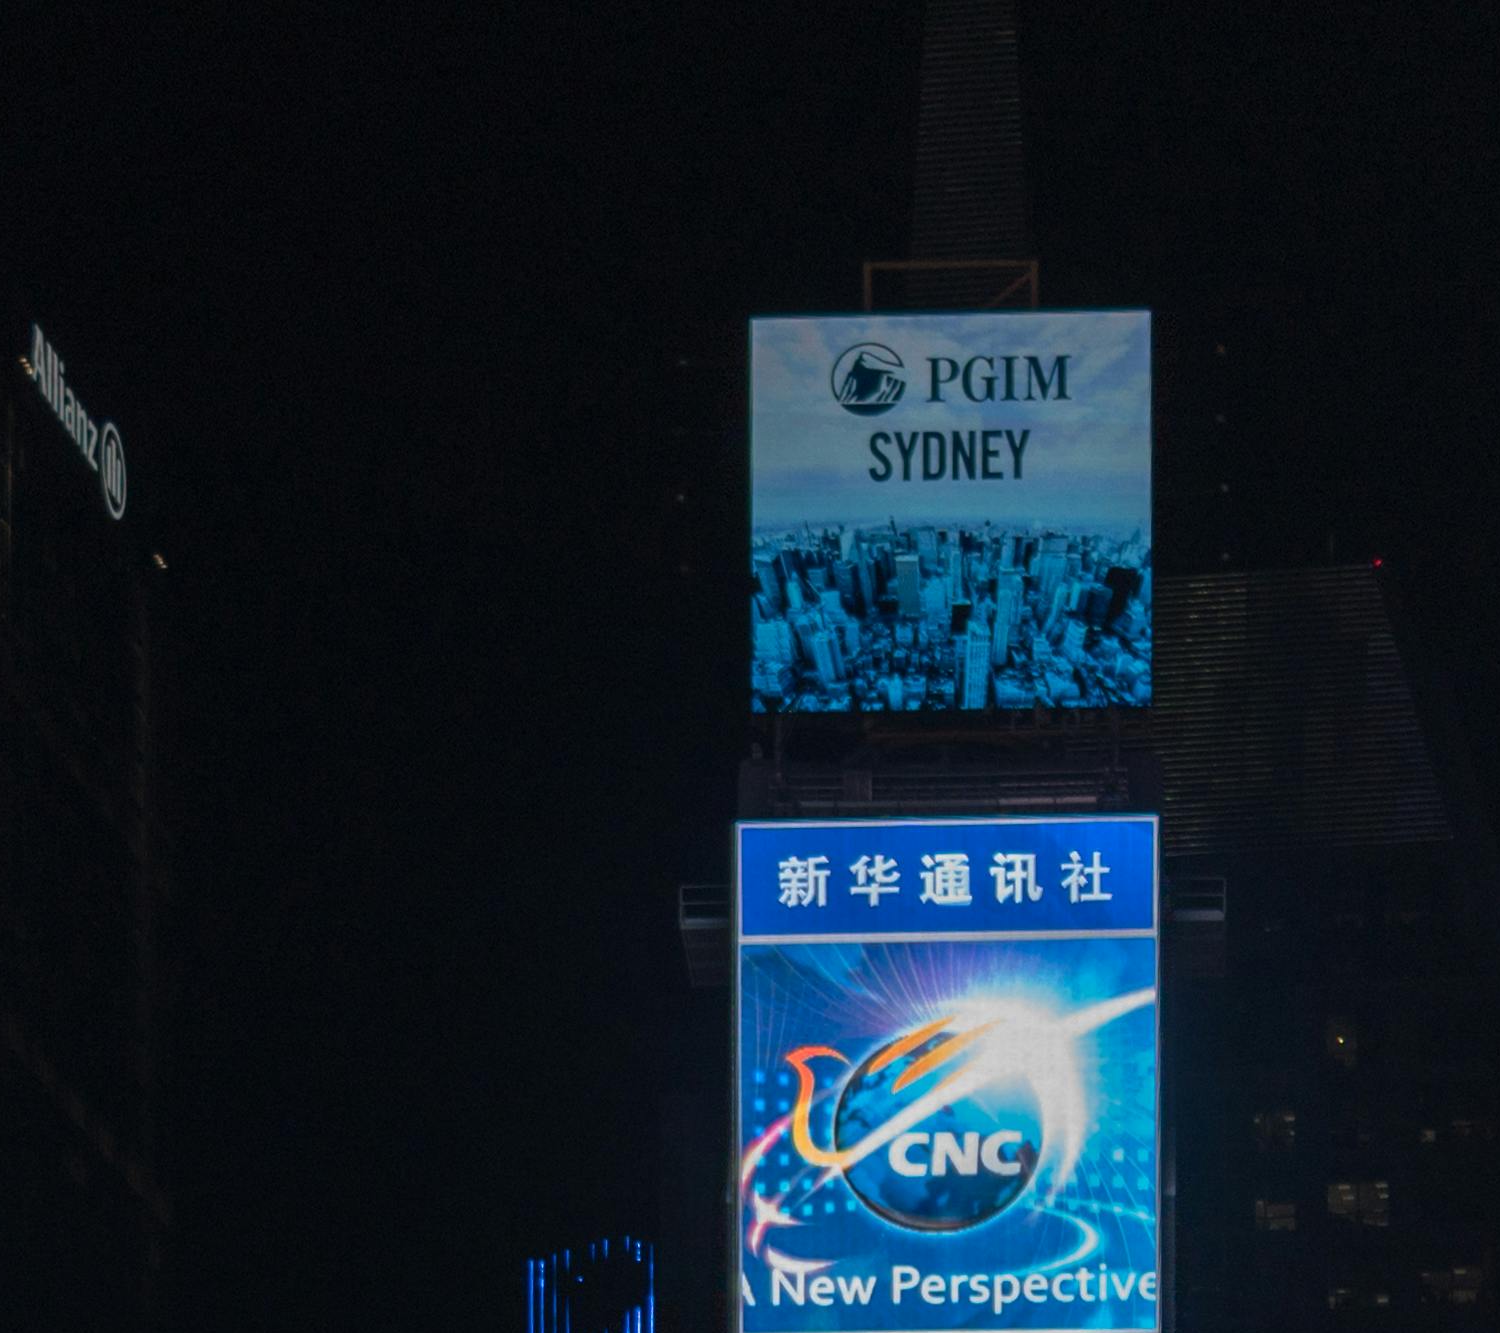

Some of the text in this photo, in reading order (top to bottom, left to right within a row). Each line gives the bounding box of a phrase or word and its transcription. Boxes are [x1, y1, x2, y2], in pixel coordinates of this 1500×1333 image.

[31, 324, 99, 471] Allianz
[927, 354, 1072, 402] PGIM
[869, 429, 1030, 482] SYDNEY
[778, 851, 1113, 907] 新华通讯社
[888, 1130, 1023, 1176] CNC
[771, 1264, 1156, 1314] New Perspective
